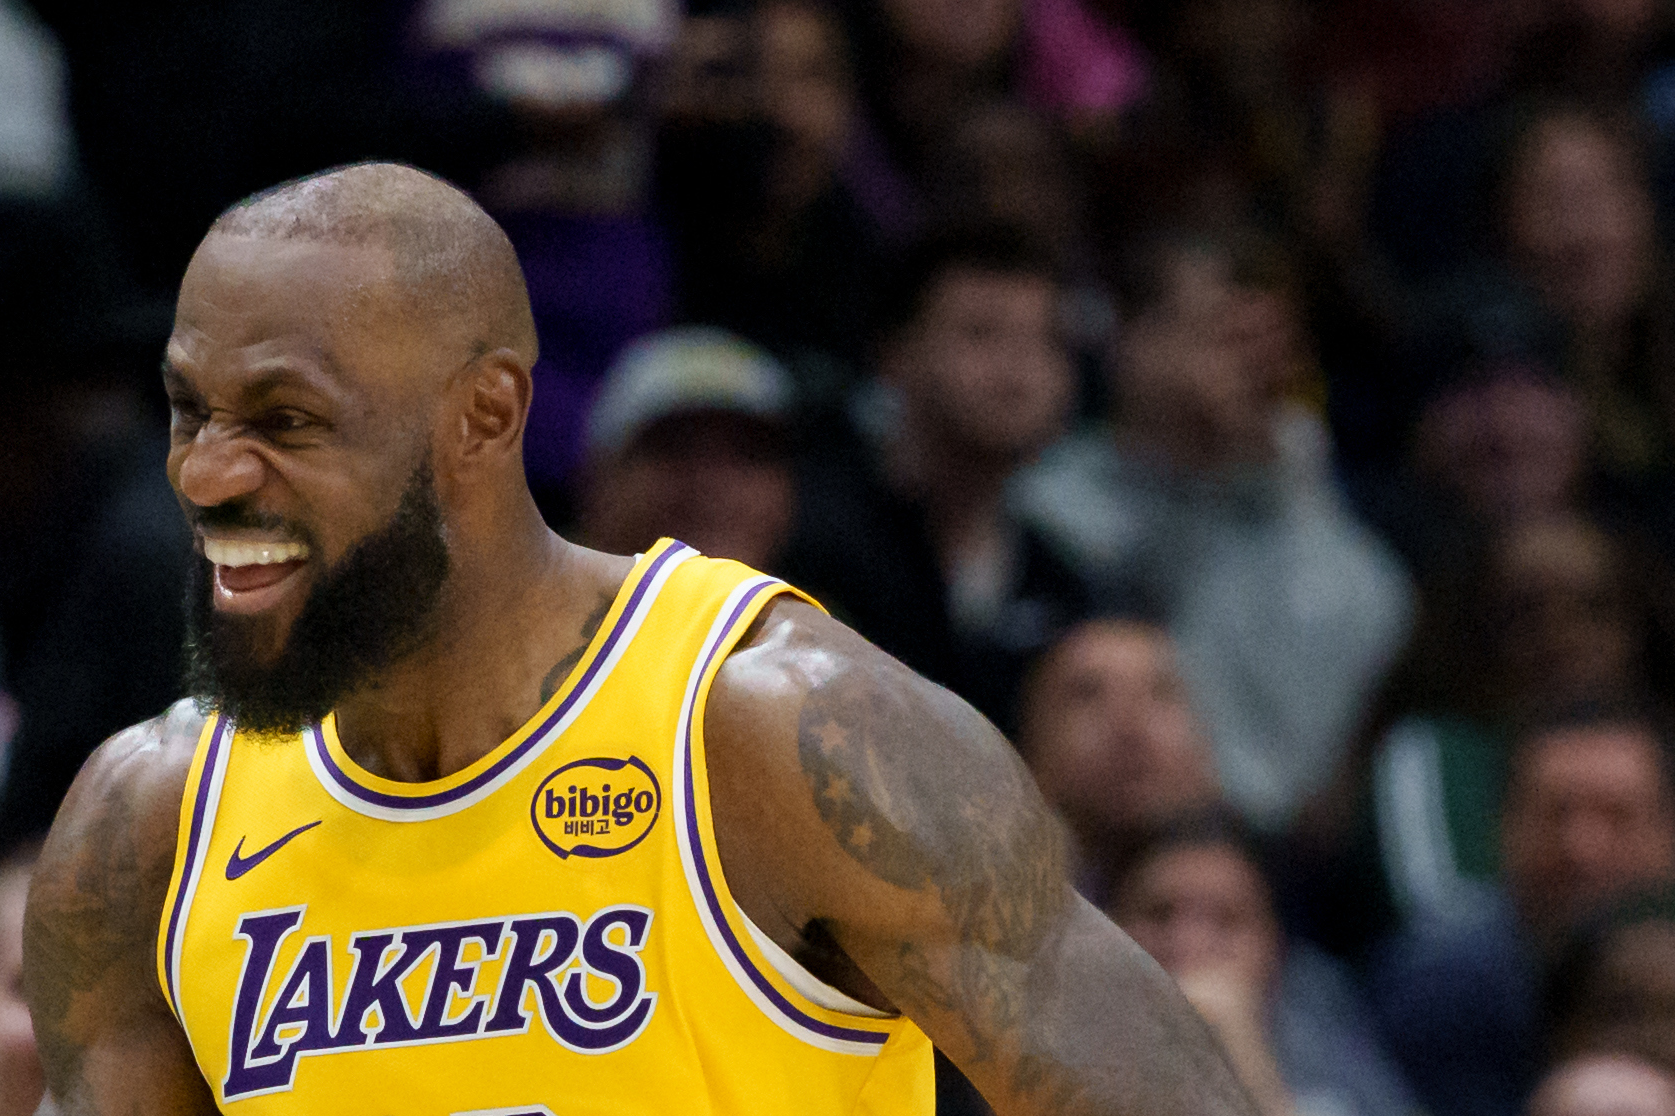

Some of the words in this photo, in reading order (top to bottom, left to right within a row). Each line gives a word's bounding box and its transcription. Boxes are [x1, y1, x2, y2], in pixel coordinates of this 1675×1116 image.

[545, 784, 654, 826] bibigo
[564, 819, 611, 837] 비비고
[222, 903, 658, 1104] LAKERS
